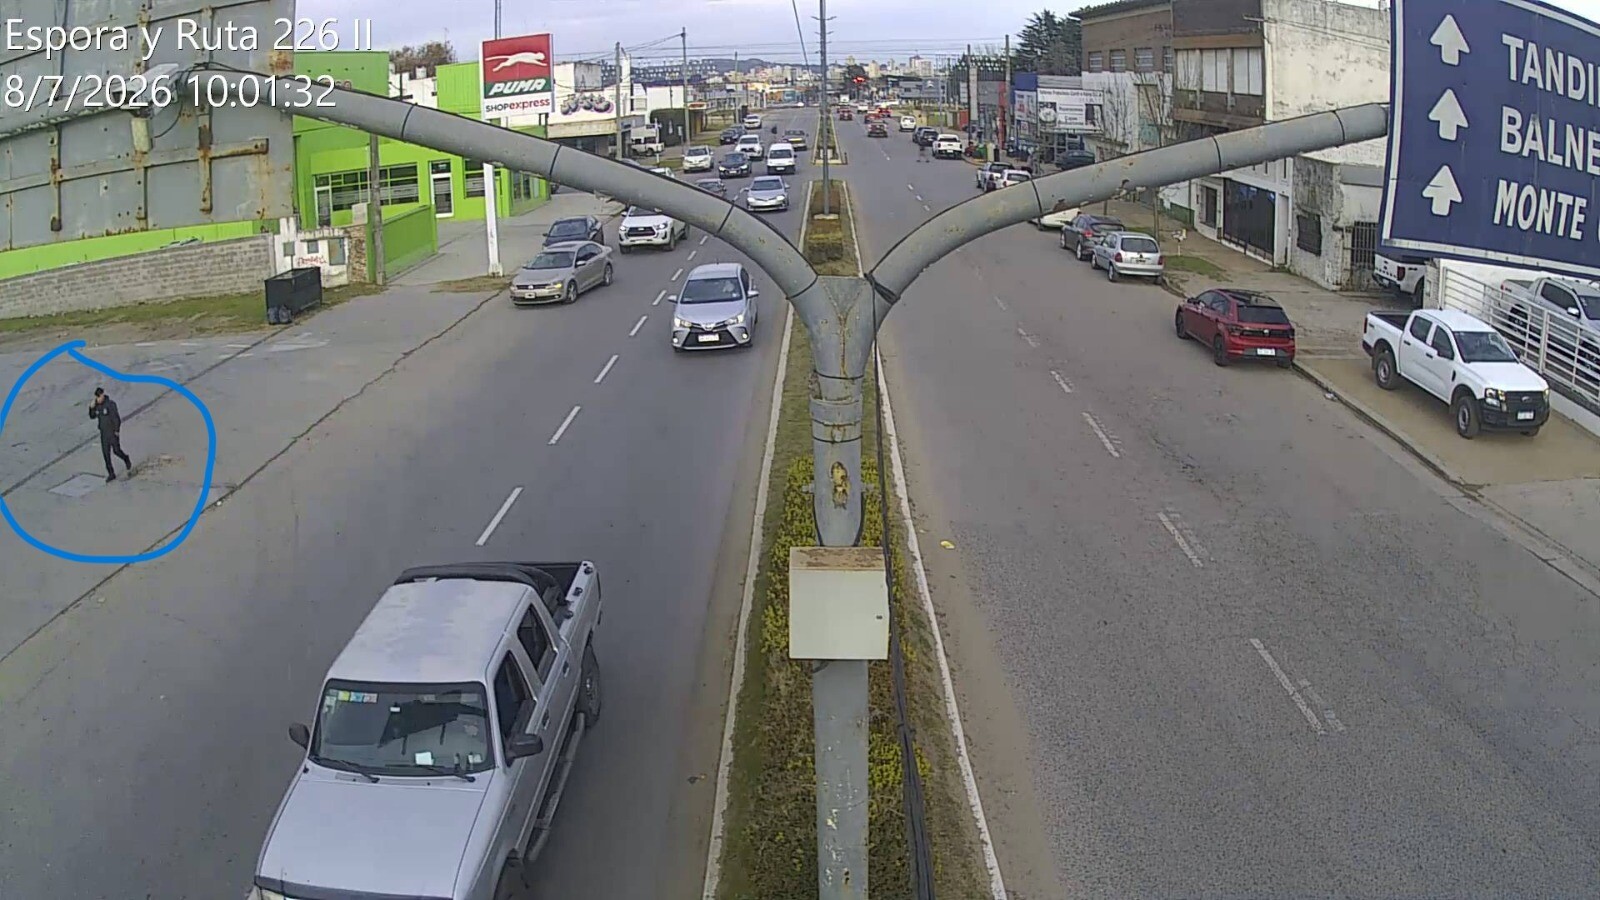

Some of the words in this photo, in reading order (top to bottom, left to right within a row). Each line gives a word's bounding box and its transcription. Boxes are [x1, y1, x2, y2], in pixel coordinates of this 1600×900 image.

[489, 79, 546, 95] PUMA
[1502, 33, 1600, 108] TANDI
[1493, 178, 1587, 240] MONTE
